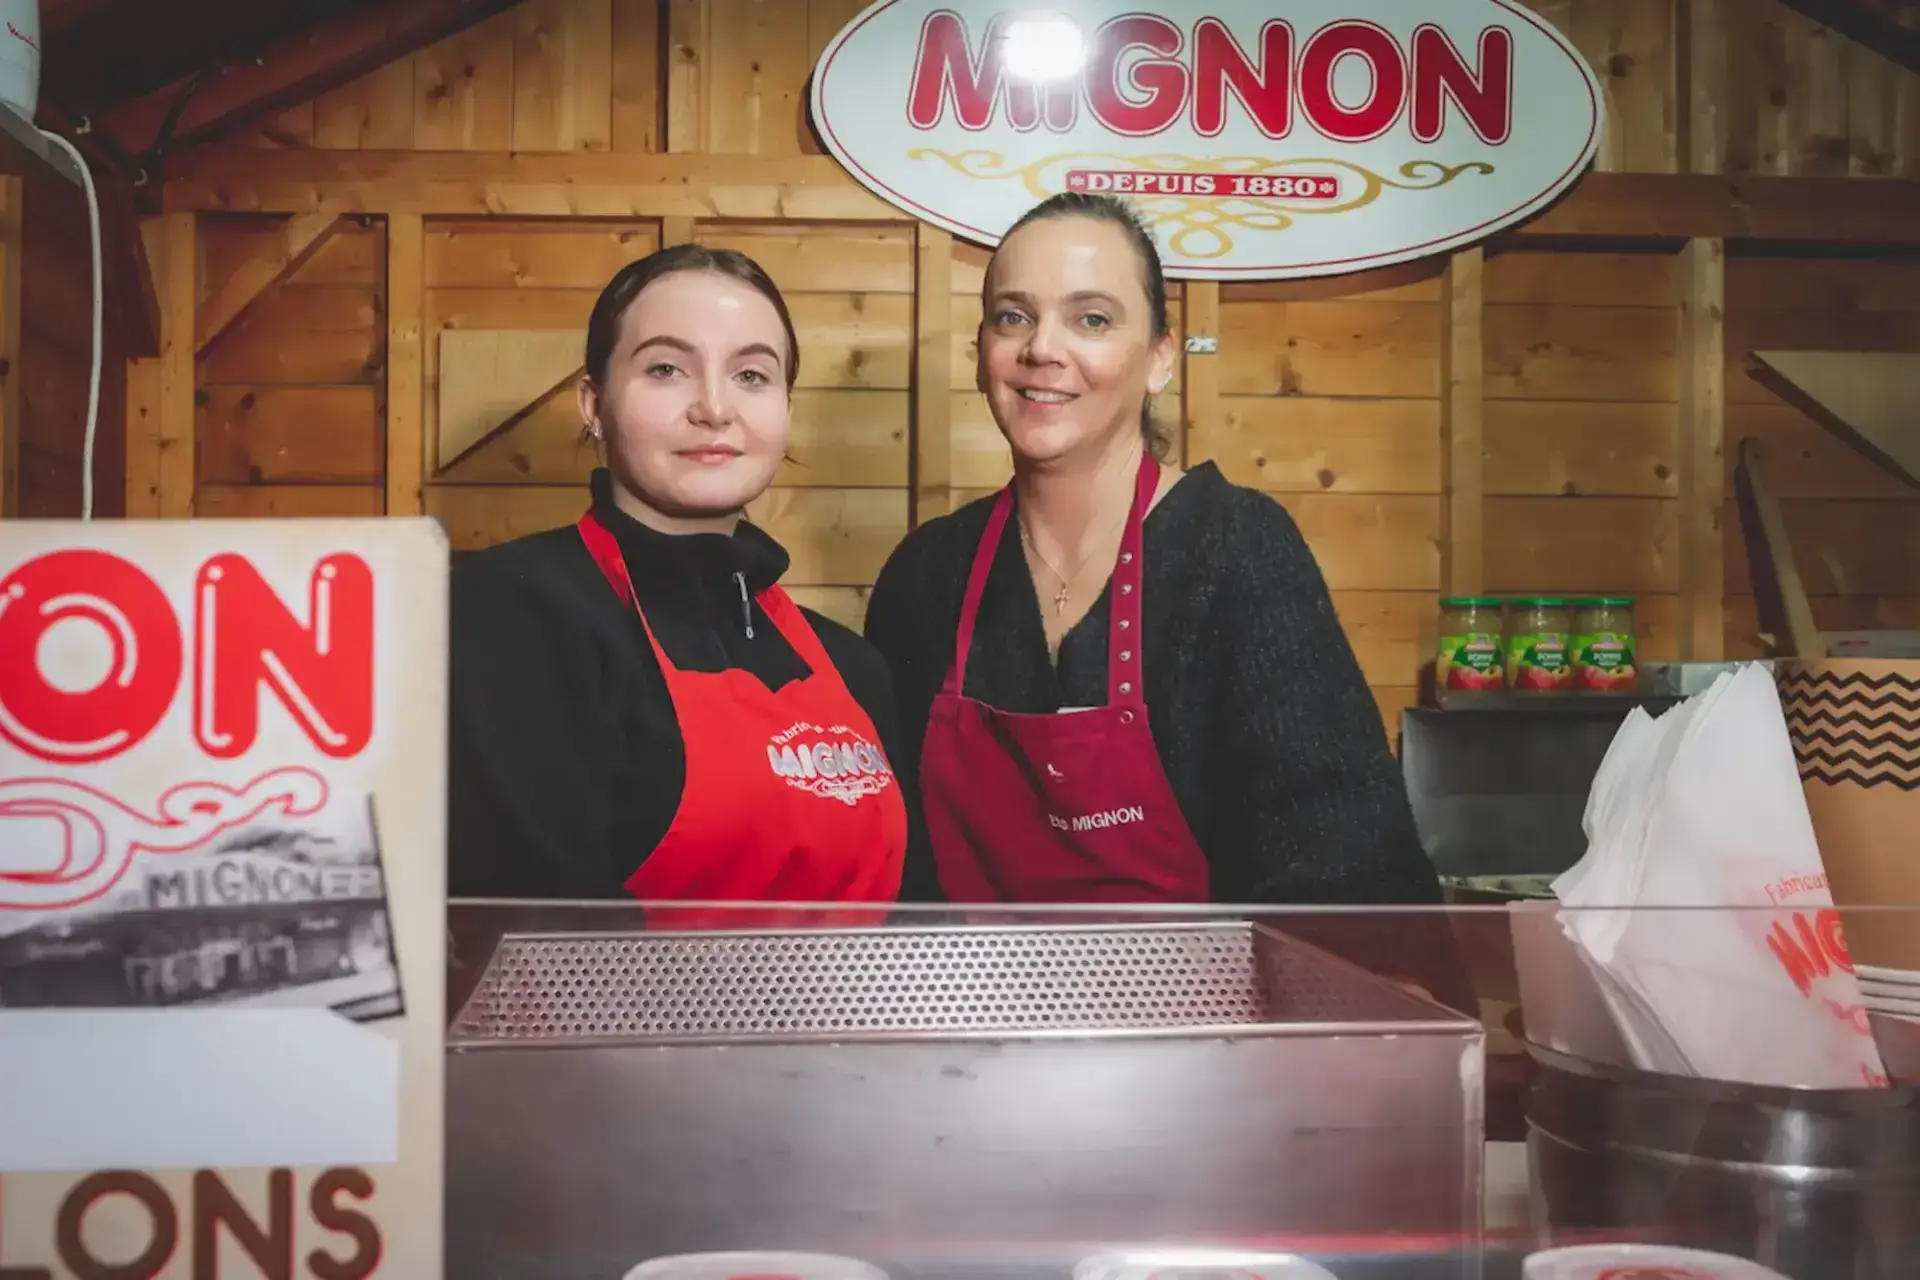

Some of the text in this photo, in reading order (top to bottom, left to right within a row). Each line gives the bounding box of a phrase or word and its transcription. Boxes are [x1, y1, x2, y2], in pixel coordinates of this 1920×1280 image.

[906, 9, 1513, 146] MIGNON
[1086, 173, 1317, 197] DEPUIS 1880
[1072, 805, 1144, 831] MIGNON
